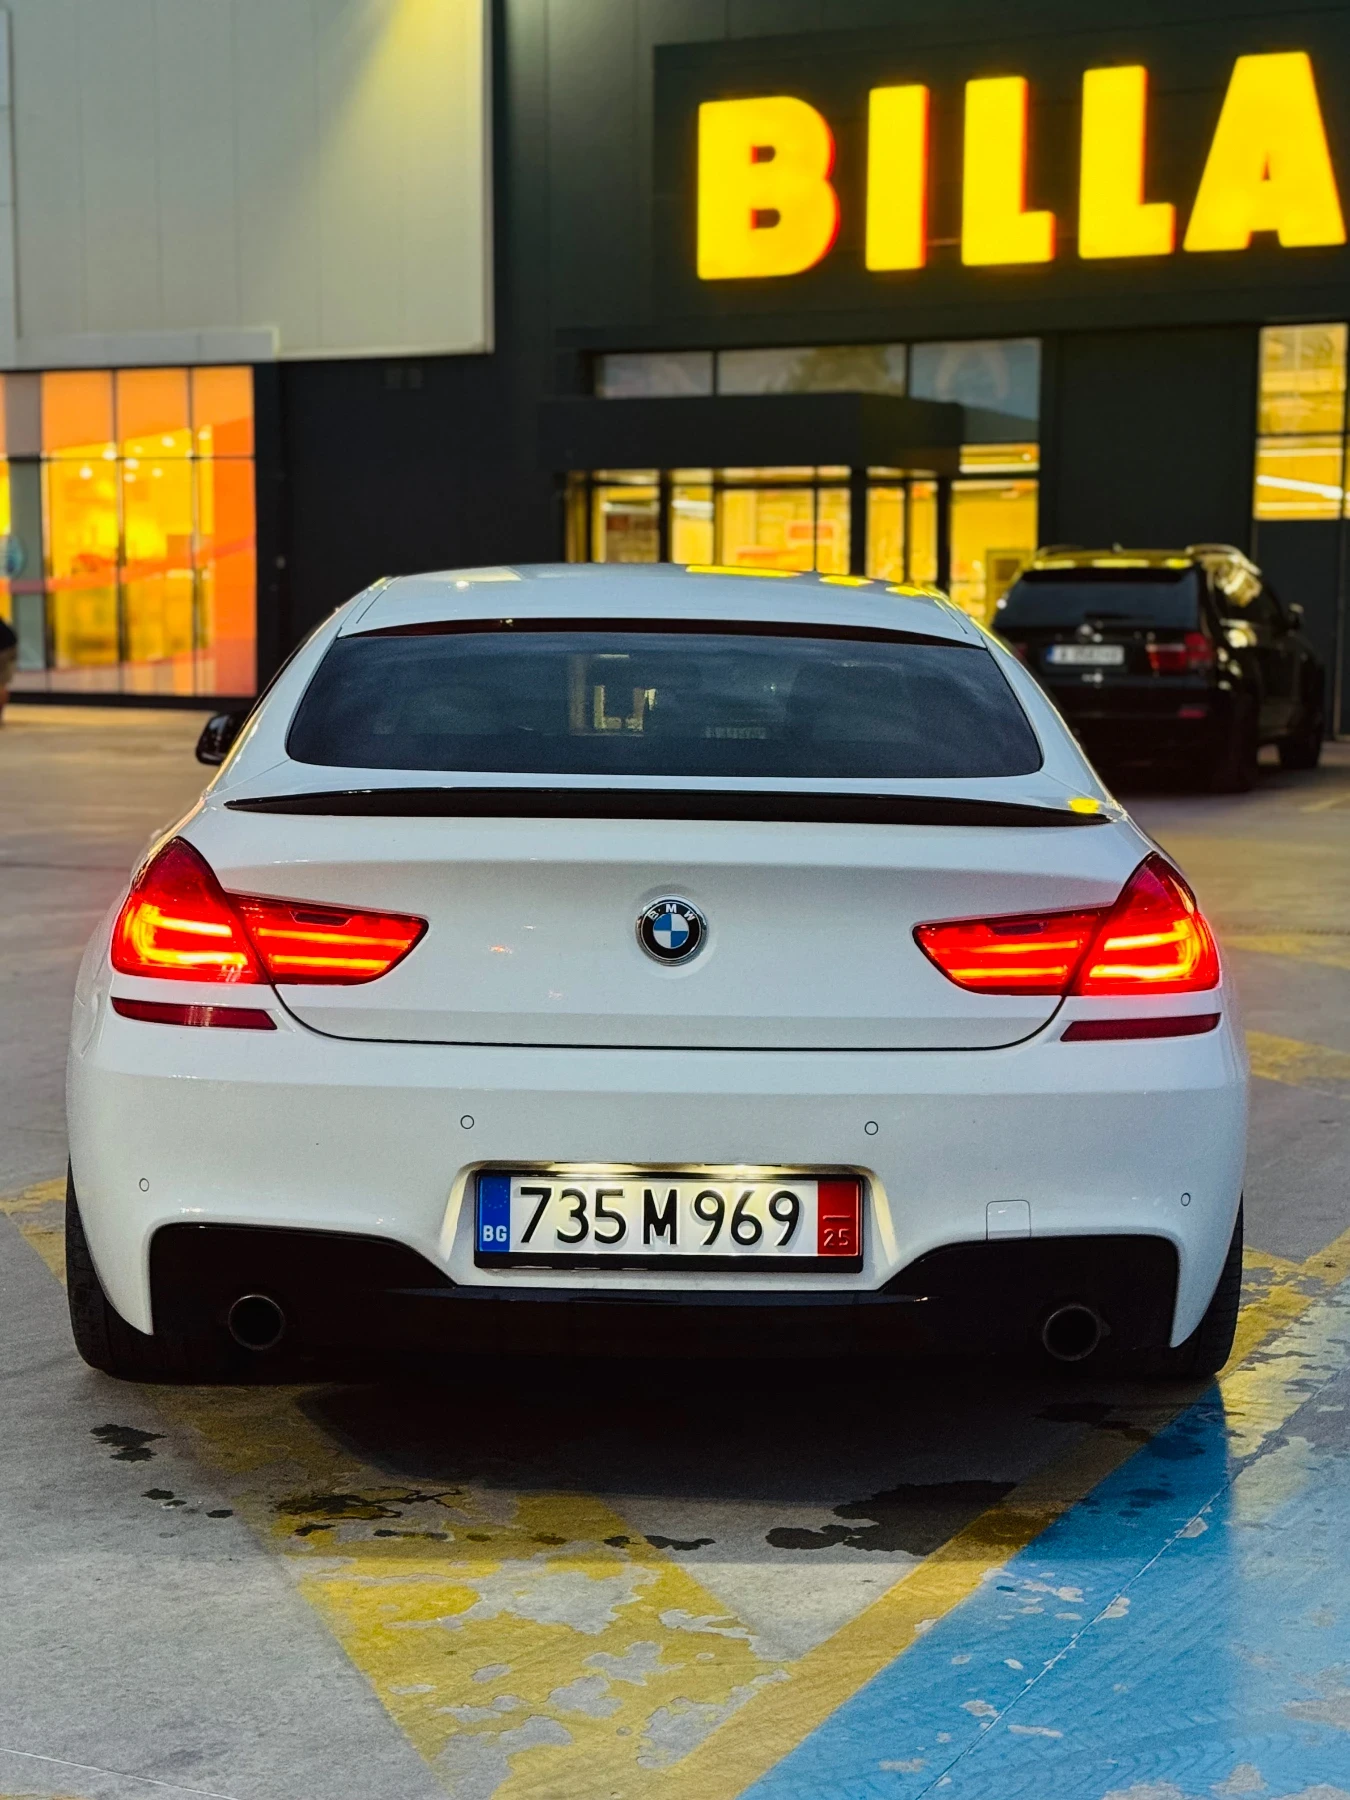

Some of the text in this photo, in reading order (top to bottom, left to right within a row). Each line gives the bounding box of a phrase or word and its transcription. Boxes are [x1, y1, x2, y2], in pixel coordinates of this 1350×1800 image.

[697, 51, 1347, 280] BILLA
[647, 903, 697, 921] BMW
[520, 1186, 800, 1247] 735 M 969
[482, 1224, 508, 1243] BG
[823, 1228, 851, 1247] 25
